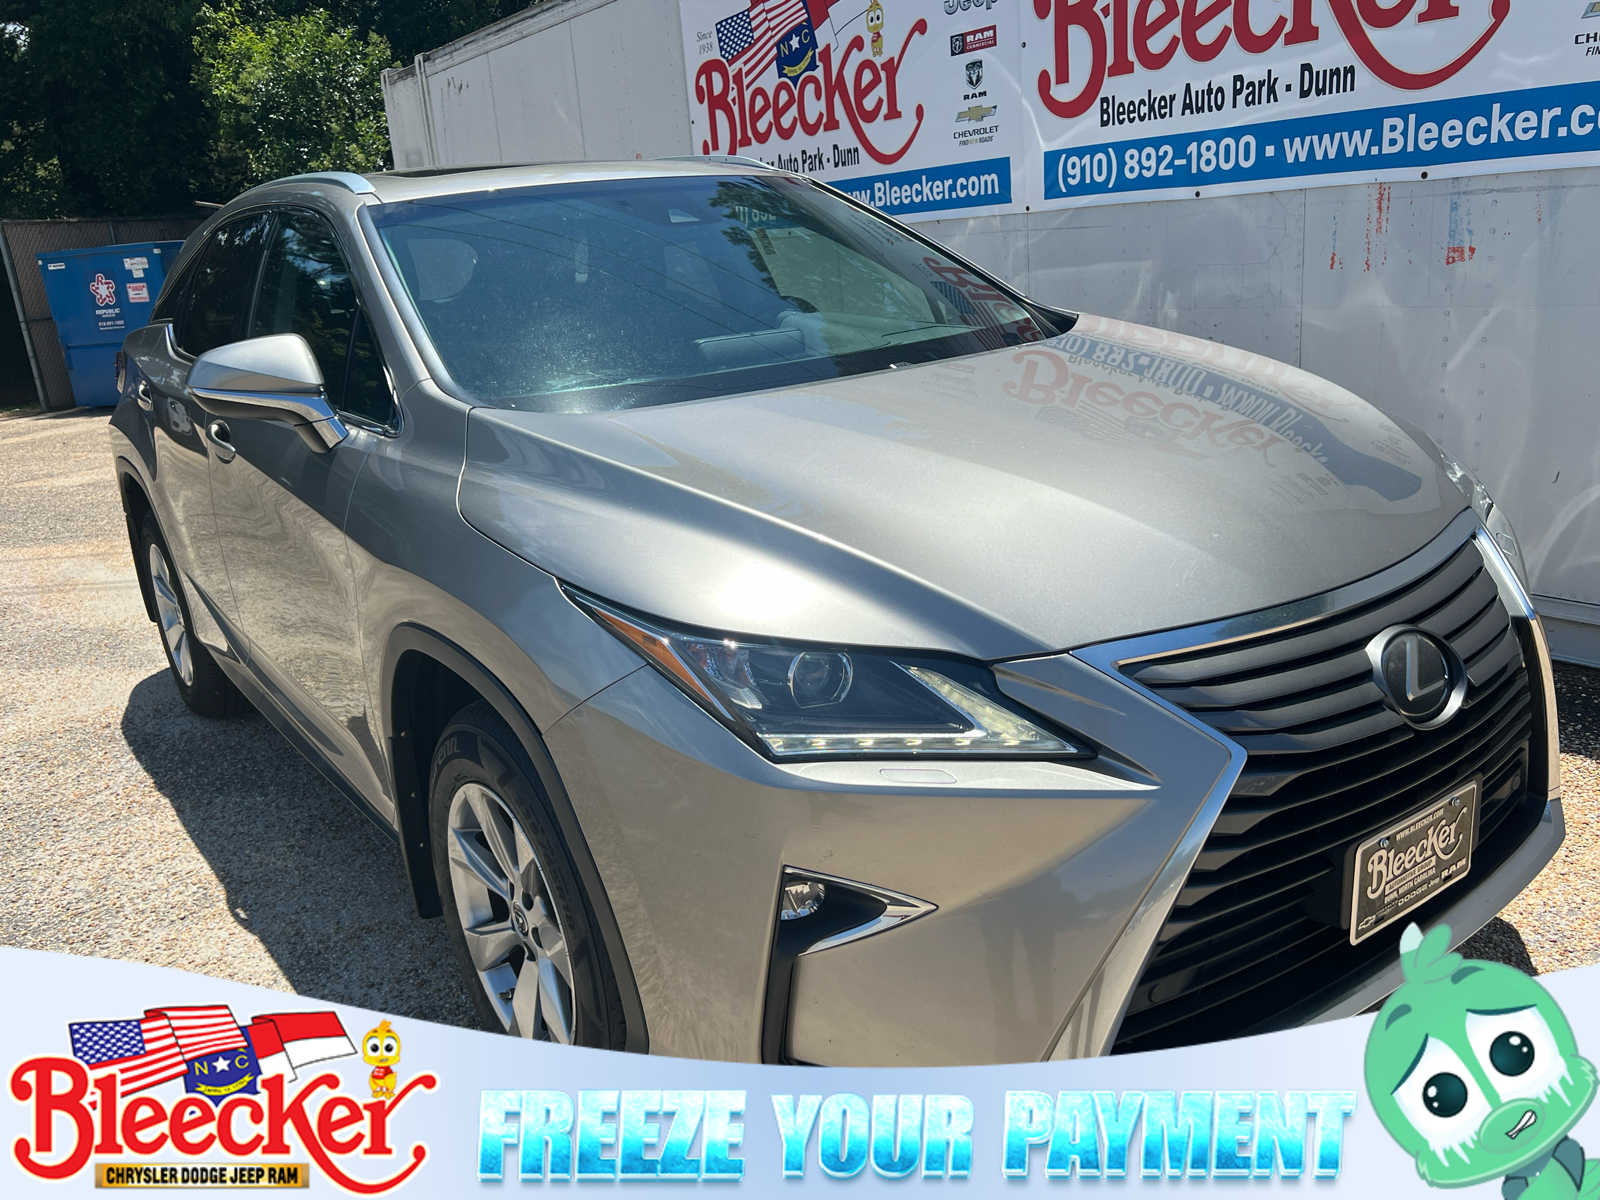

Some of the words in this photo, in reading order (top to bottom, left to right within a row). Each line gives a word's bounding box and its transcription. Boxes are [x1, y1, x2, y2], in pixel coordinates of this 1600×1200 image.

[966, 30, 994, 42] RAM
[1038, 0, 1511, 119] Bleec
[695, 18, 927, 165] Bleecker
[963, 91, 987, 100] RAM
[1100, 89, 1176, 127] Bleecker
[1181, 82, 1224, 116] Auto
[1232, 69, 1279, 109] Park
[1299, 62, 1356, 99] Dunn
[953, 125, 999, 139] CHEVROLET
[1057, 148, 1117, 192] (910)
[1124, 134, 1257, 180] 892-1800
[1283, 102, 1600, 163] www.Bleecker.c
[778, 154, 799, 173] Auto
[802, 147, 824, 173] Park
[833, 144, 860, 168] Dunn
[1367, 806, 1468, 899] Bleecker
[1441, 858, 1467, 879] RAM
